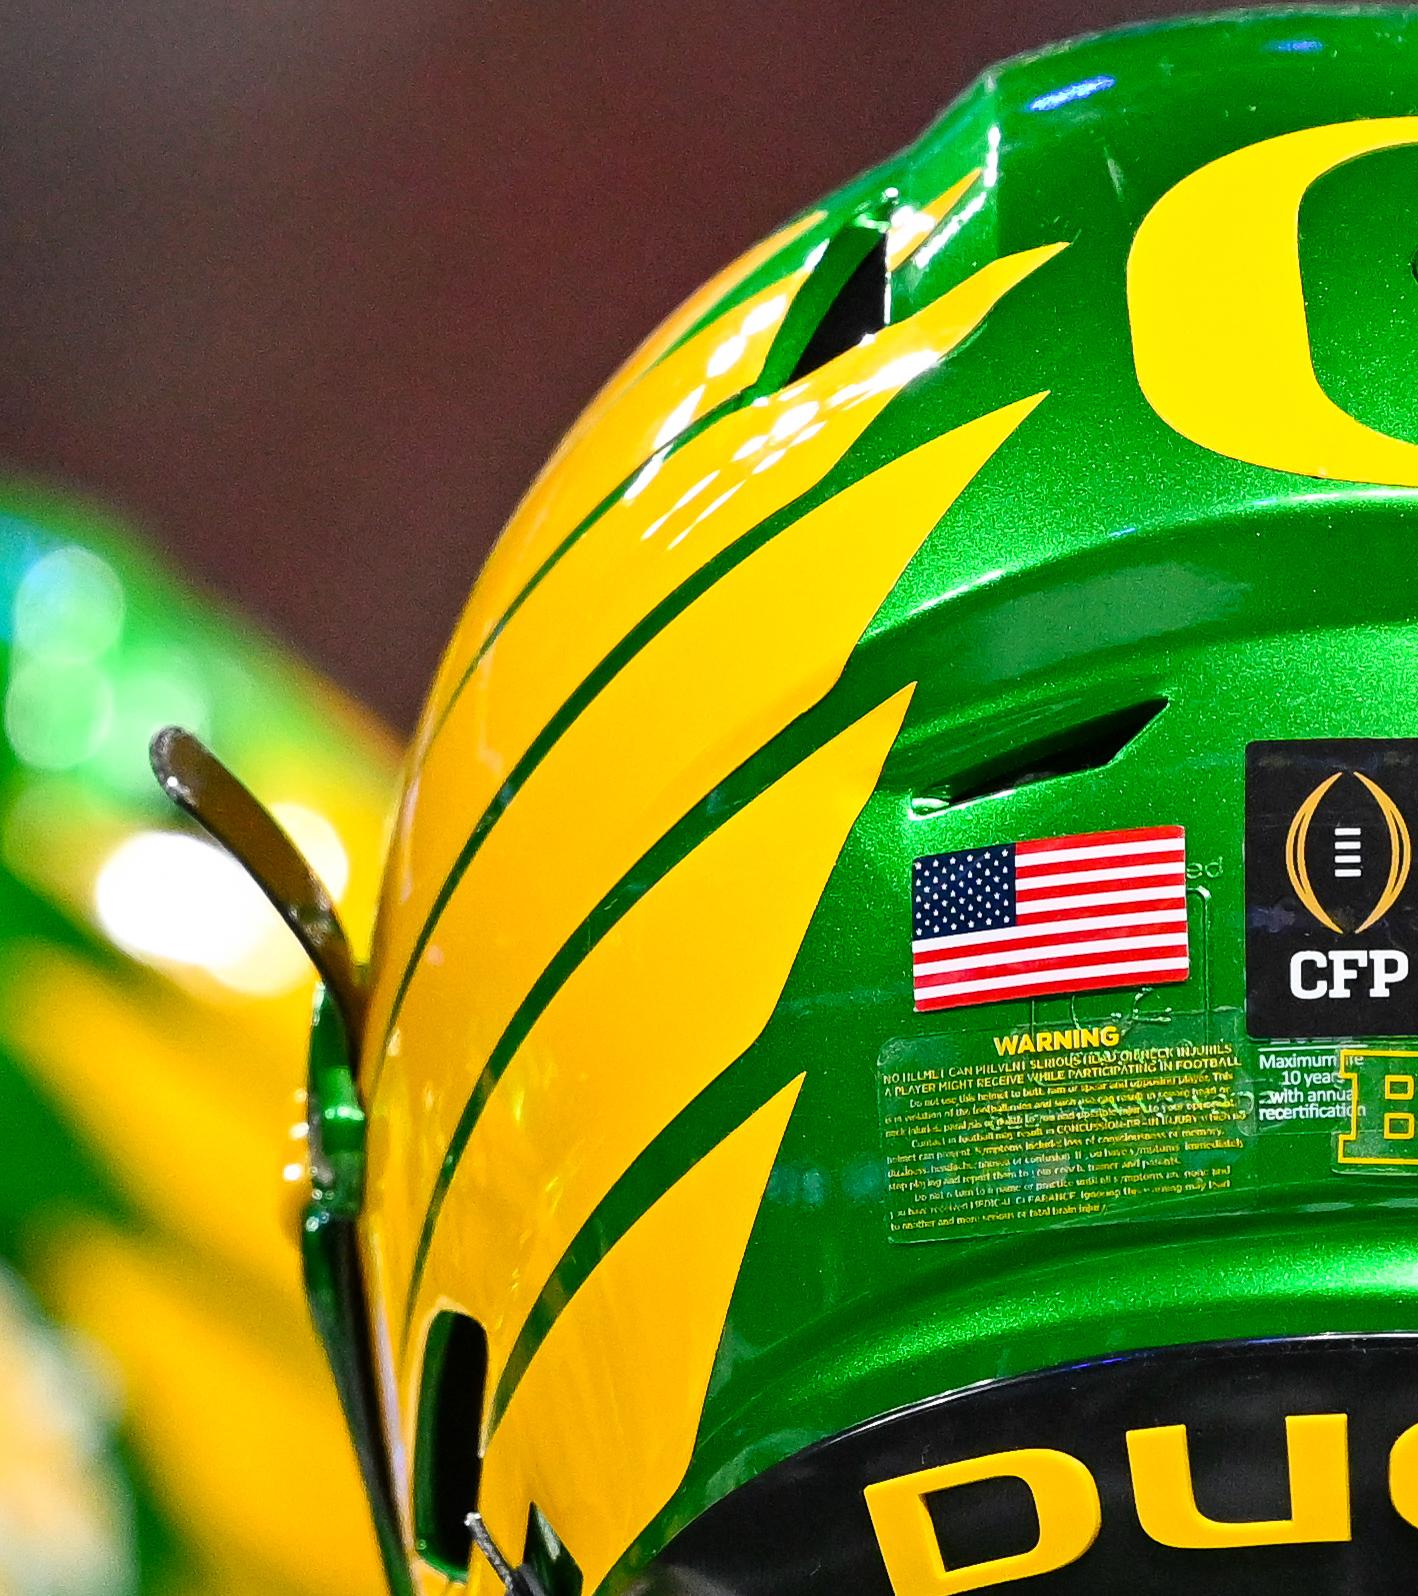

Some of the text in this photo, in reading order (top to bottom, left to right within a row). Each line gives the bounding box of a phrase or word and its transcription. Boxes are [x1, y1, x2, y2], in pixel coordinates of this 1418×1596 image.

[1289, 950, 1409, 1000] CFP
[993, 1026, 1120, 1057] WARNING
[1259, 1053, 1337, 1069] Maximum
[894, 1083, 935, 1095] PLAYER
[938, 1079, 973, 1091] MIGHT
[976, 1074, 1024, 1087] RECEIVE
[1026, 1070, 1066, 1082] WHILE
[1067, 1062, 1156, 1079] PARTICIPATING
[1175, 1056, 1242, 1069] FOOTBALL
[948, 1066, 972, 1077] CAN
[1281, 1070, 1301, 1086] 10
[977, 1090, 1008, 1101] helmet
[1269, 1088, 1354, 1104] with annua
[1259, 1103, 1366, 1121] recertification
